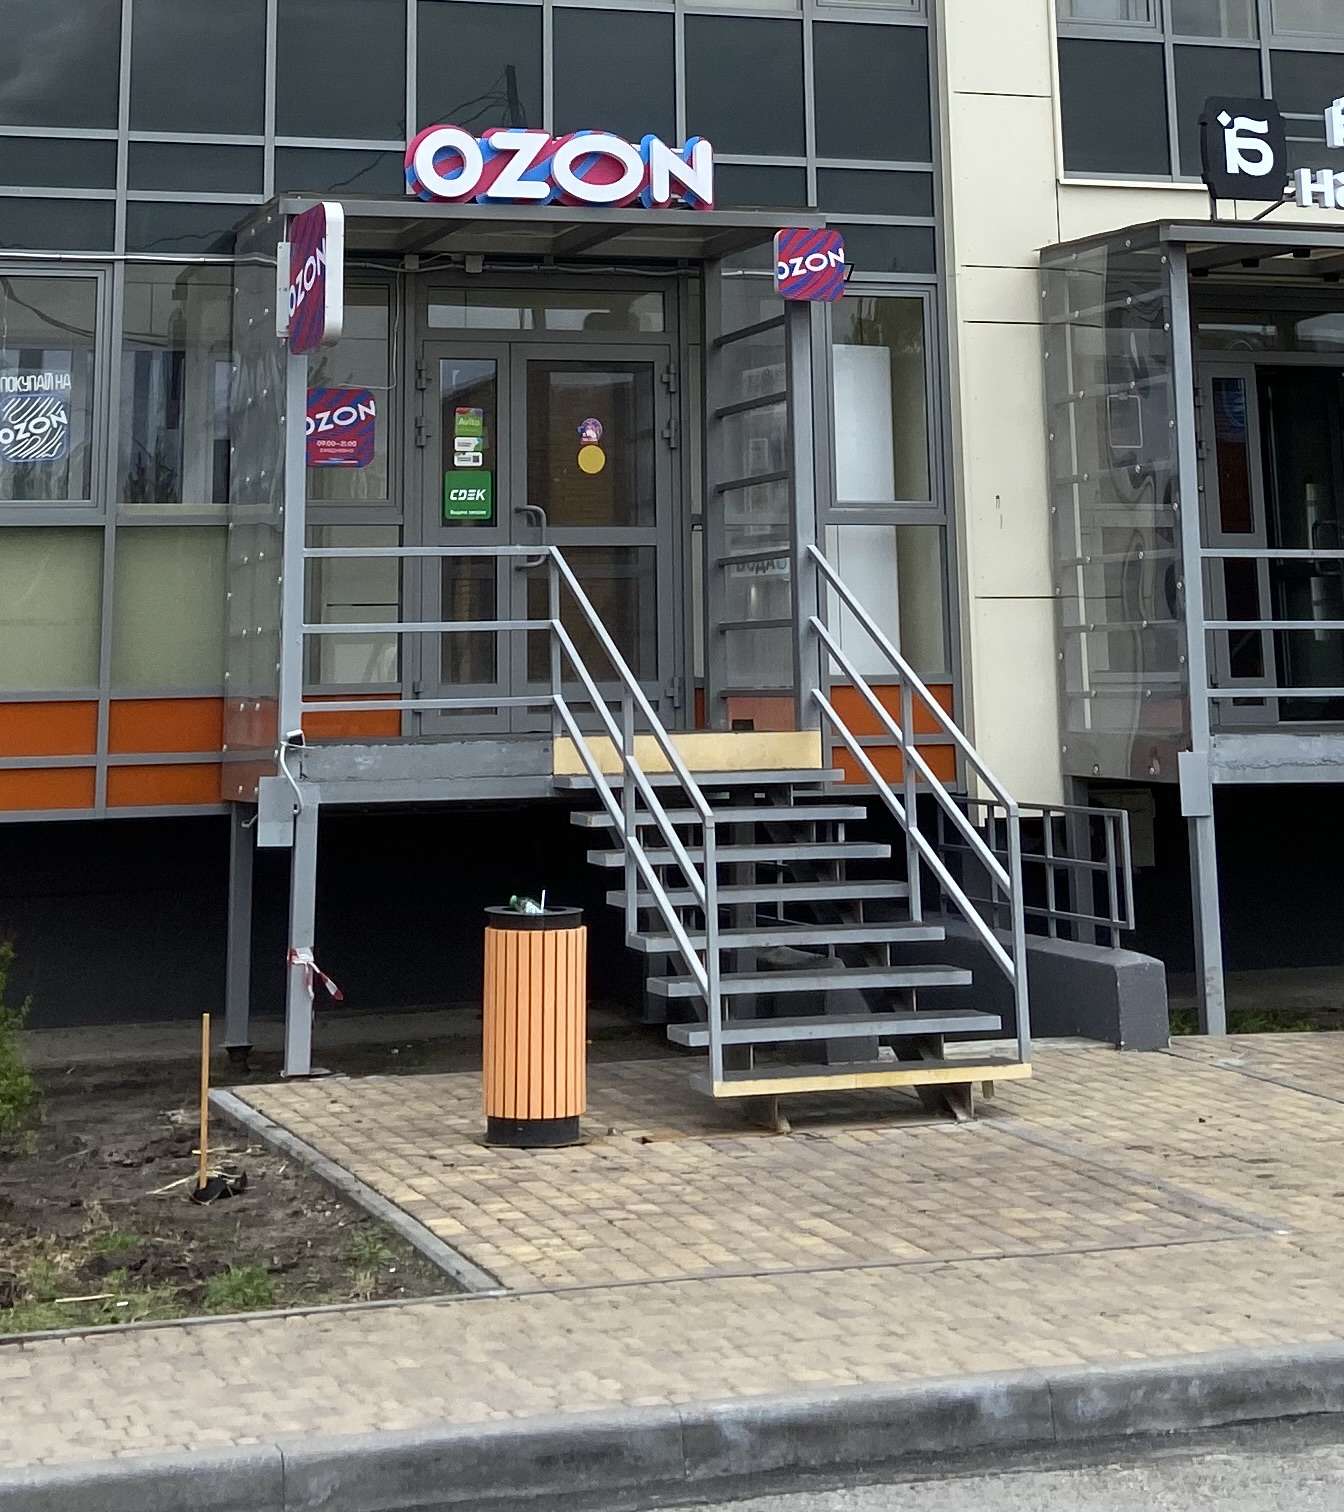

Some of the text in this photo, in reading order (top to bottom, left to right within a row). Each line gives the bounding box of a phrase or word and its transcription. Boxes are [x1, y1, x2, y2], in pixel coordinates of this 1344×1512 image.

[412, 127, 714, 206] OZON
[289, 237, 327, 318] OZON
[777, 247, 845, 281] OZON
[0, 372, 72, 393] ПОКУПАЙ НА
[449, 489, 487, 501] CDEK
